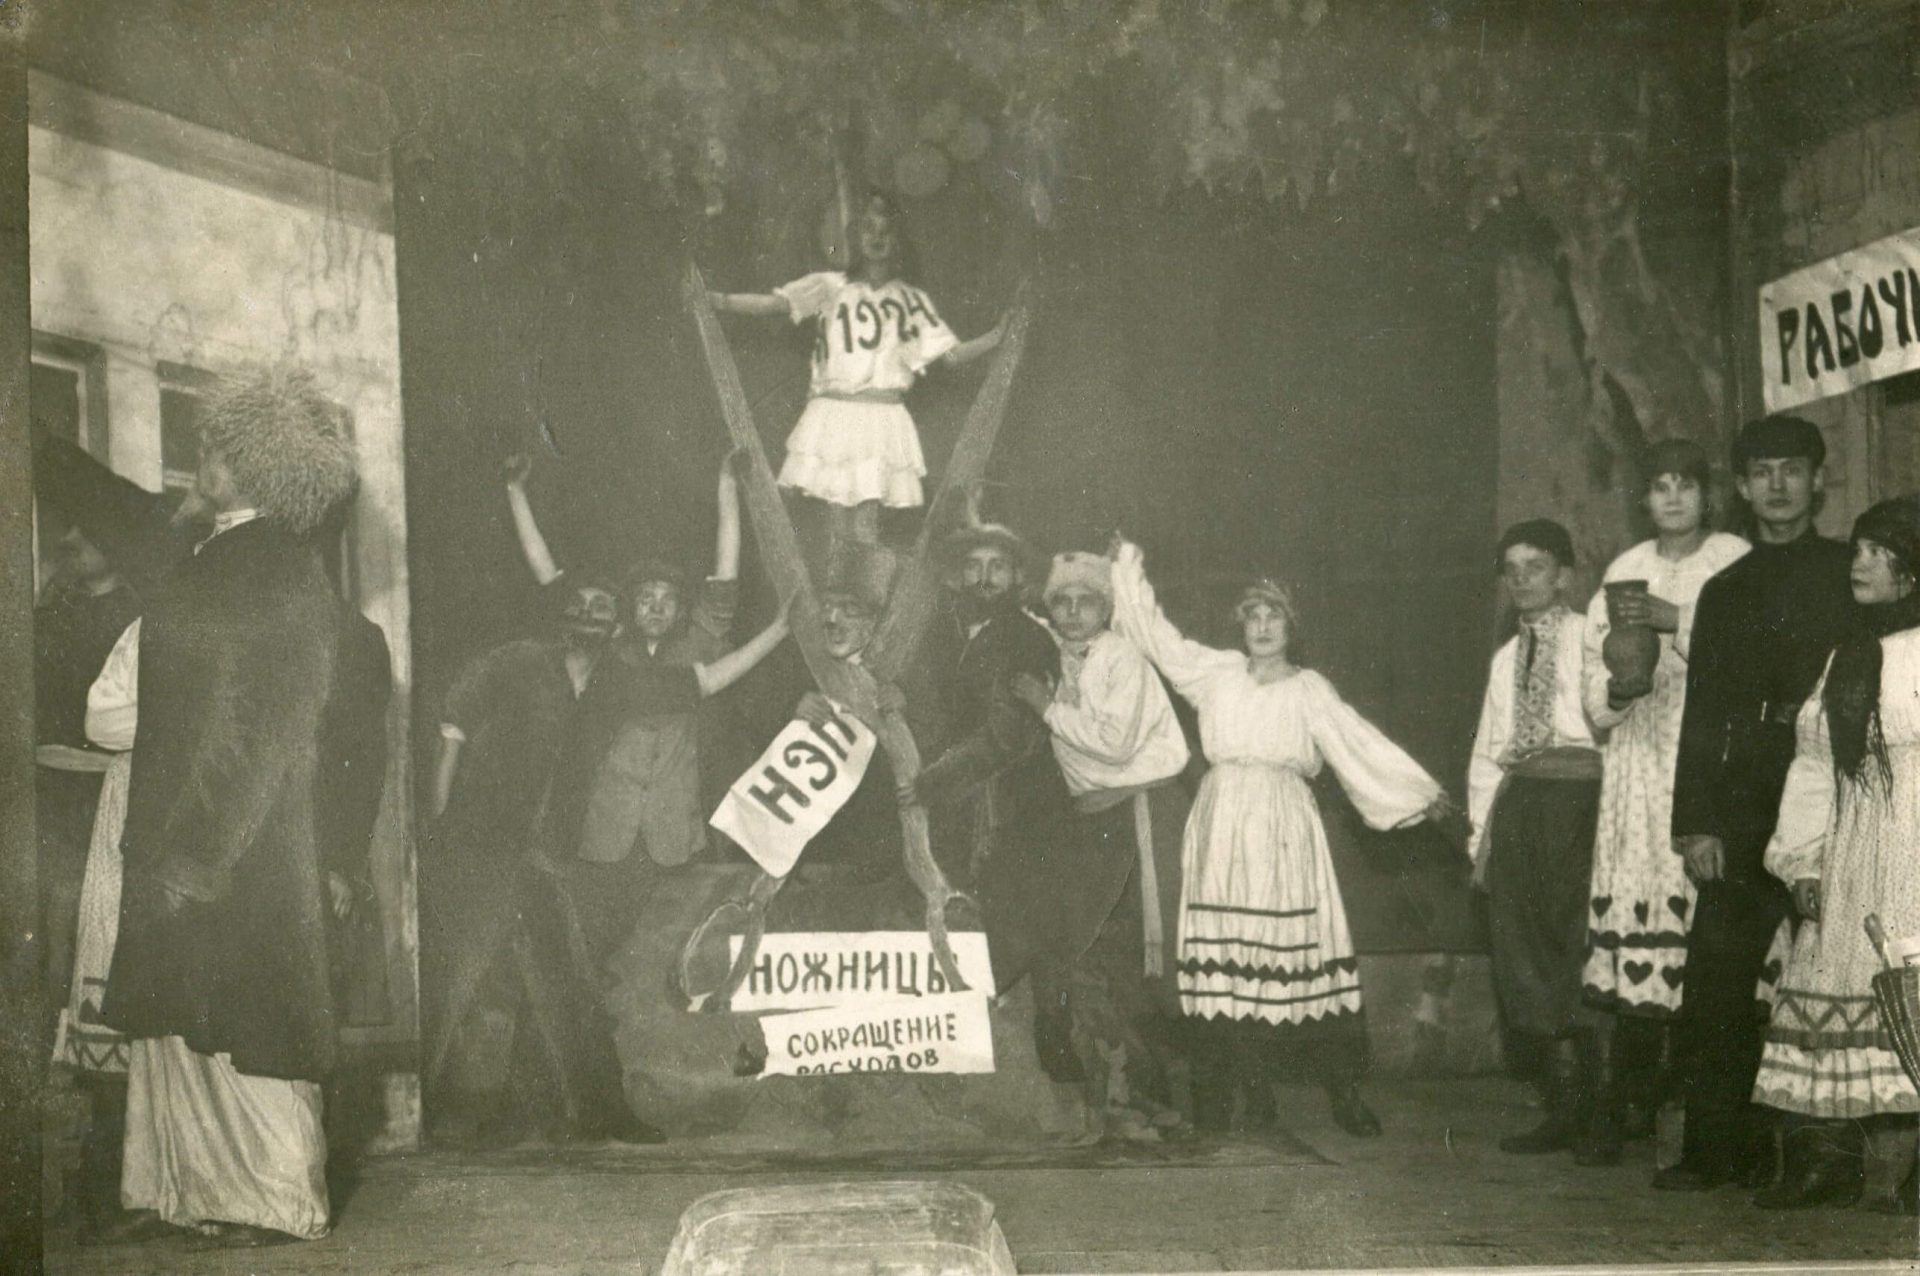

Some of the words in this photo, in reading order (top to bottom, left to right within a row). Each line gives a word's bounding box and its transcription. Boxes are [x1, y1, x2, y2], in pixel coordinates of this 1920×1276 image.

[837, 287, 939, 353] 1924
[747, 708, 857, 825] НЭП
[787, 1013, 957, 1059] СОКРАЩЕНИЕ
